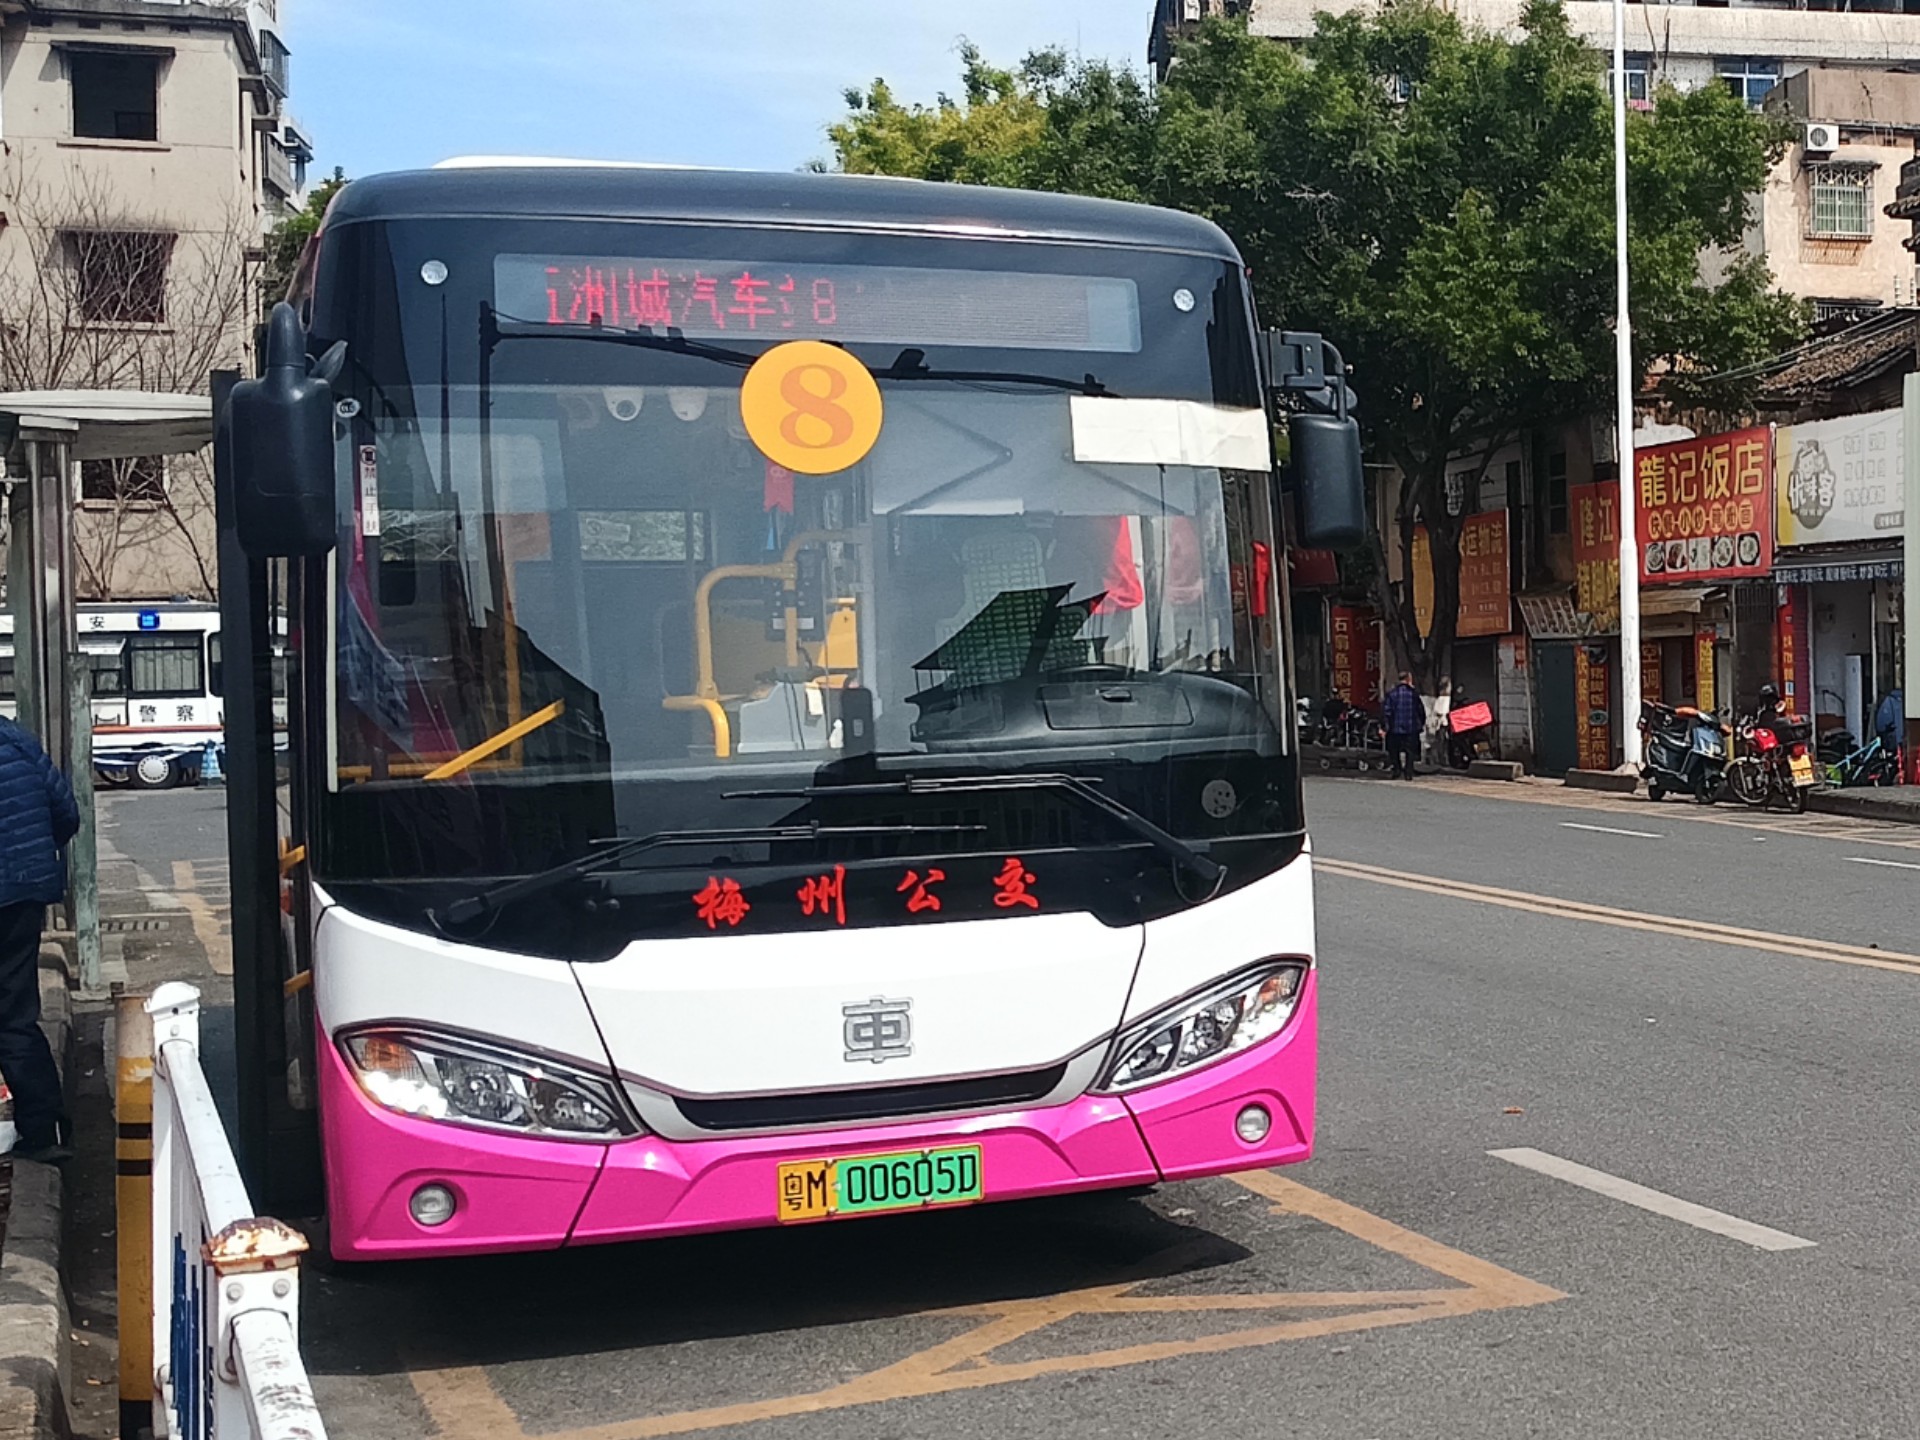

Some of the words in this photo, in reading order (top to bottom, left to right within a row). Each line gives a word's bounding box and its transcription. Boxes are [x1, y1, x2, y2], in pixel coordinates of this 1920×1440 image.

[780, 364, 855, 449] 8
[1639, 438, 1765, 509] 龍记饭店
[89, 616, 104, 630] 安
[138, 704, 194, 723] 警察
[692, 857, 1040, 930] 梅州公交
